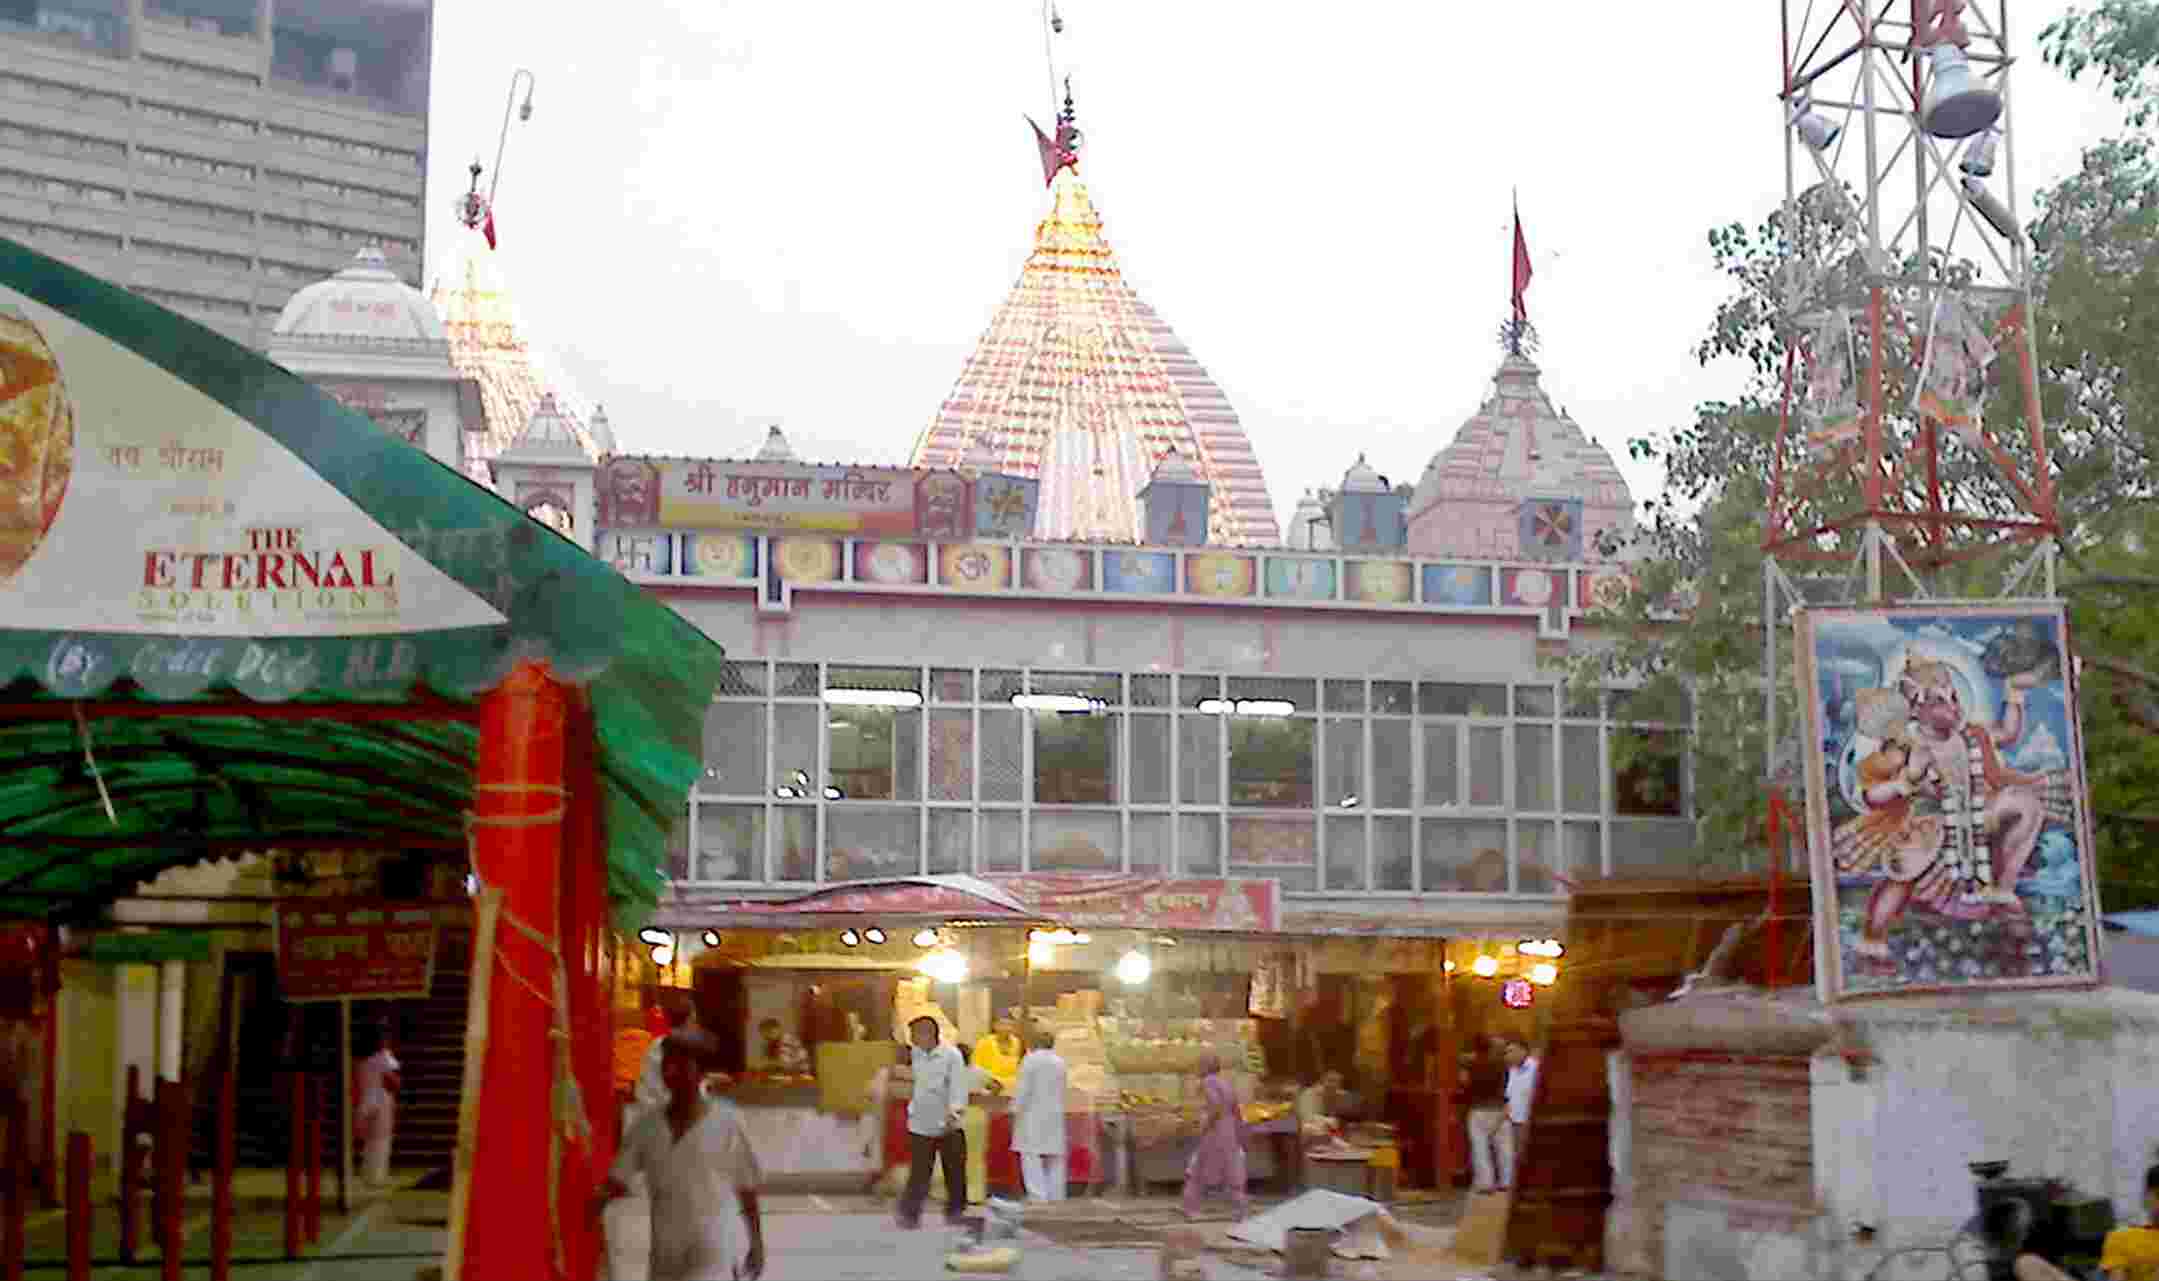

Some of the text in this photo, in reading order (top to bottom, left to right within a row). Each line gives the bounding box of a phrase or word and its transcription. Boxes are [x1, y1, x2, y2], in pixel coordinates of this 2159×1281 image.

[683, 464, 717, 494] श्री
[246, 528, 302, 550] THE
[143, 550, 396, 590] ETERNAL
